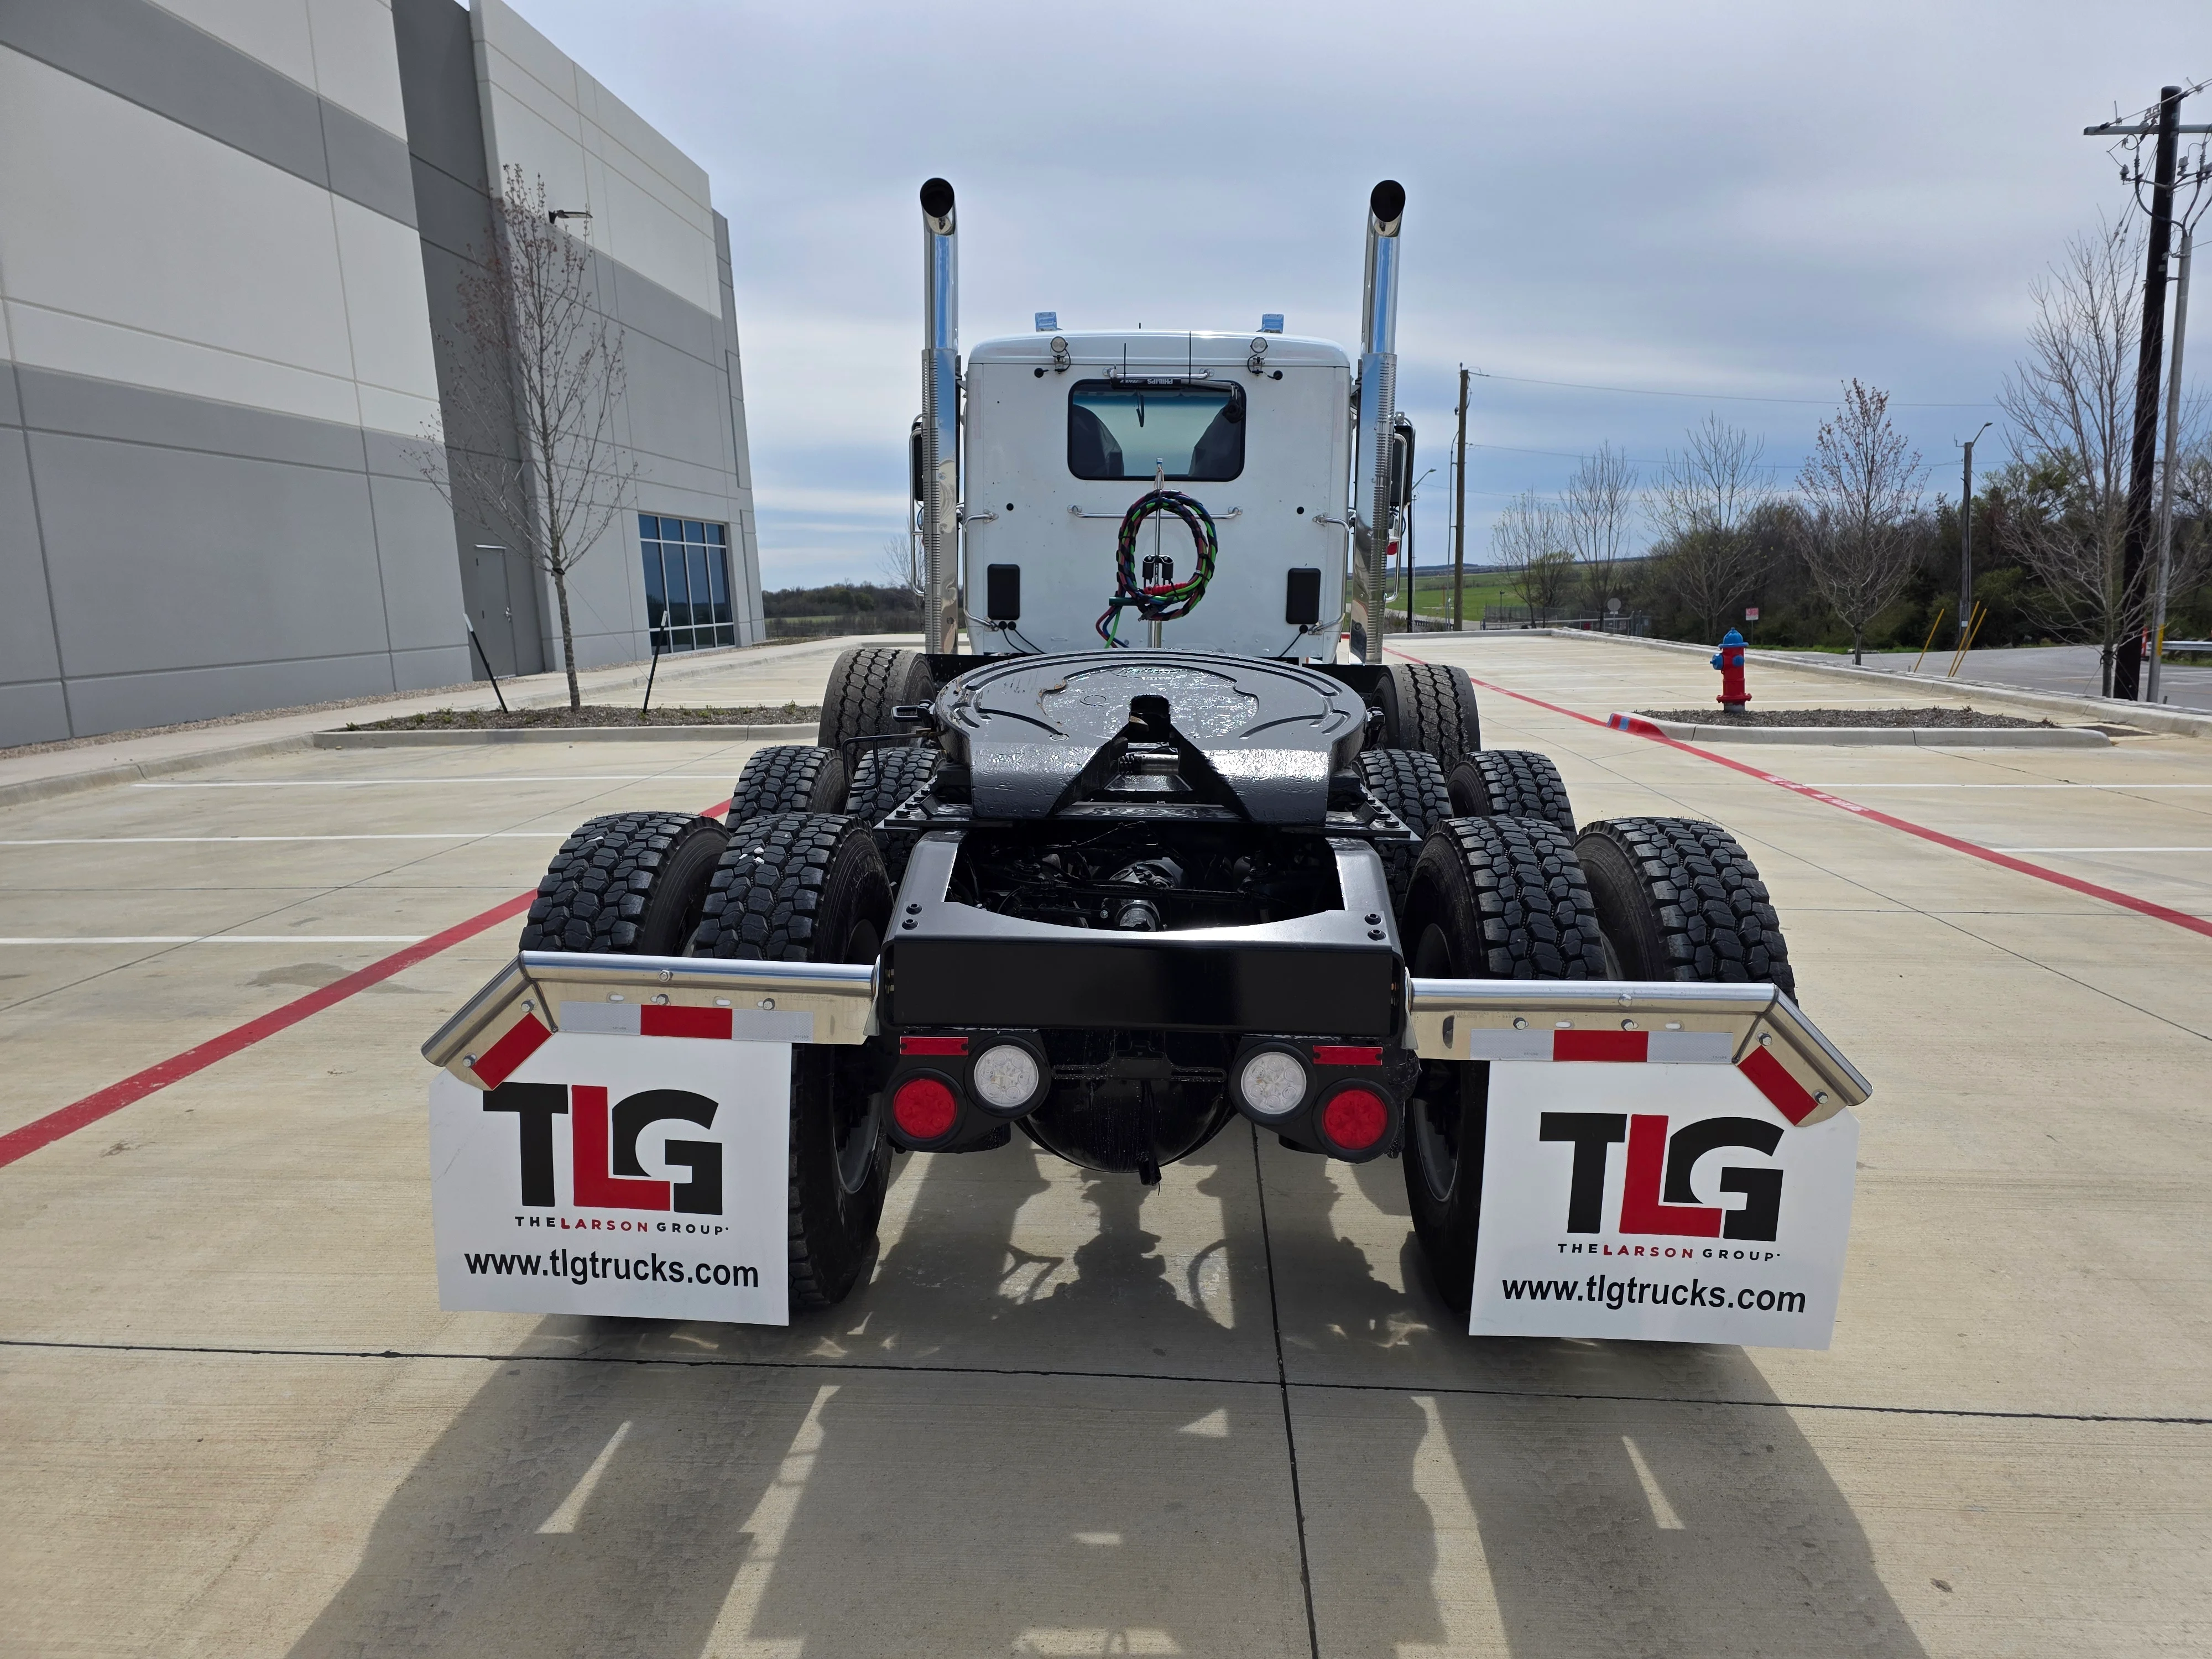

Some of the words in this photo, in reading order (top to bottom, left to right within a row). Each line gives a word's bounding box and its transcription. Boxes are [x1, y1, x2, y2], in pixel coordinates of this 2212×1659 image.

[483, 1082, 723, 1215] TLG
[1540, 1112, 1785, 1242] TLG
[515, 1216, 555, 1228] THE
[561, 1218, 648, 1232] LARSON
[656, 1222, 723, 1235] GROUP
[464, 1249, 759, 1288] www.tlgtrucks.com
[1557, 1243, 1598, 1254] THE
[1603, 1244, 1693, 1259] LARSON
[1702, 1248, 1774, 1261] GROUP
[1502, 1274, 1806, 1313] www.tlgtrucks.com
